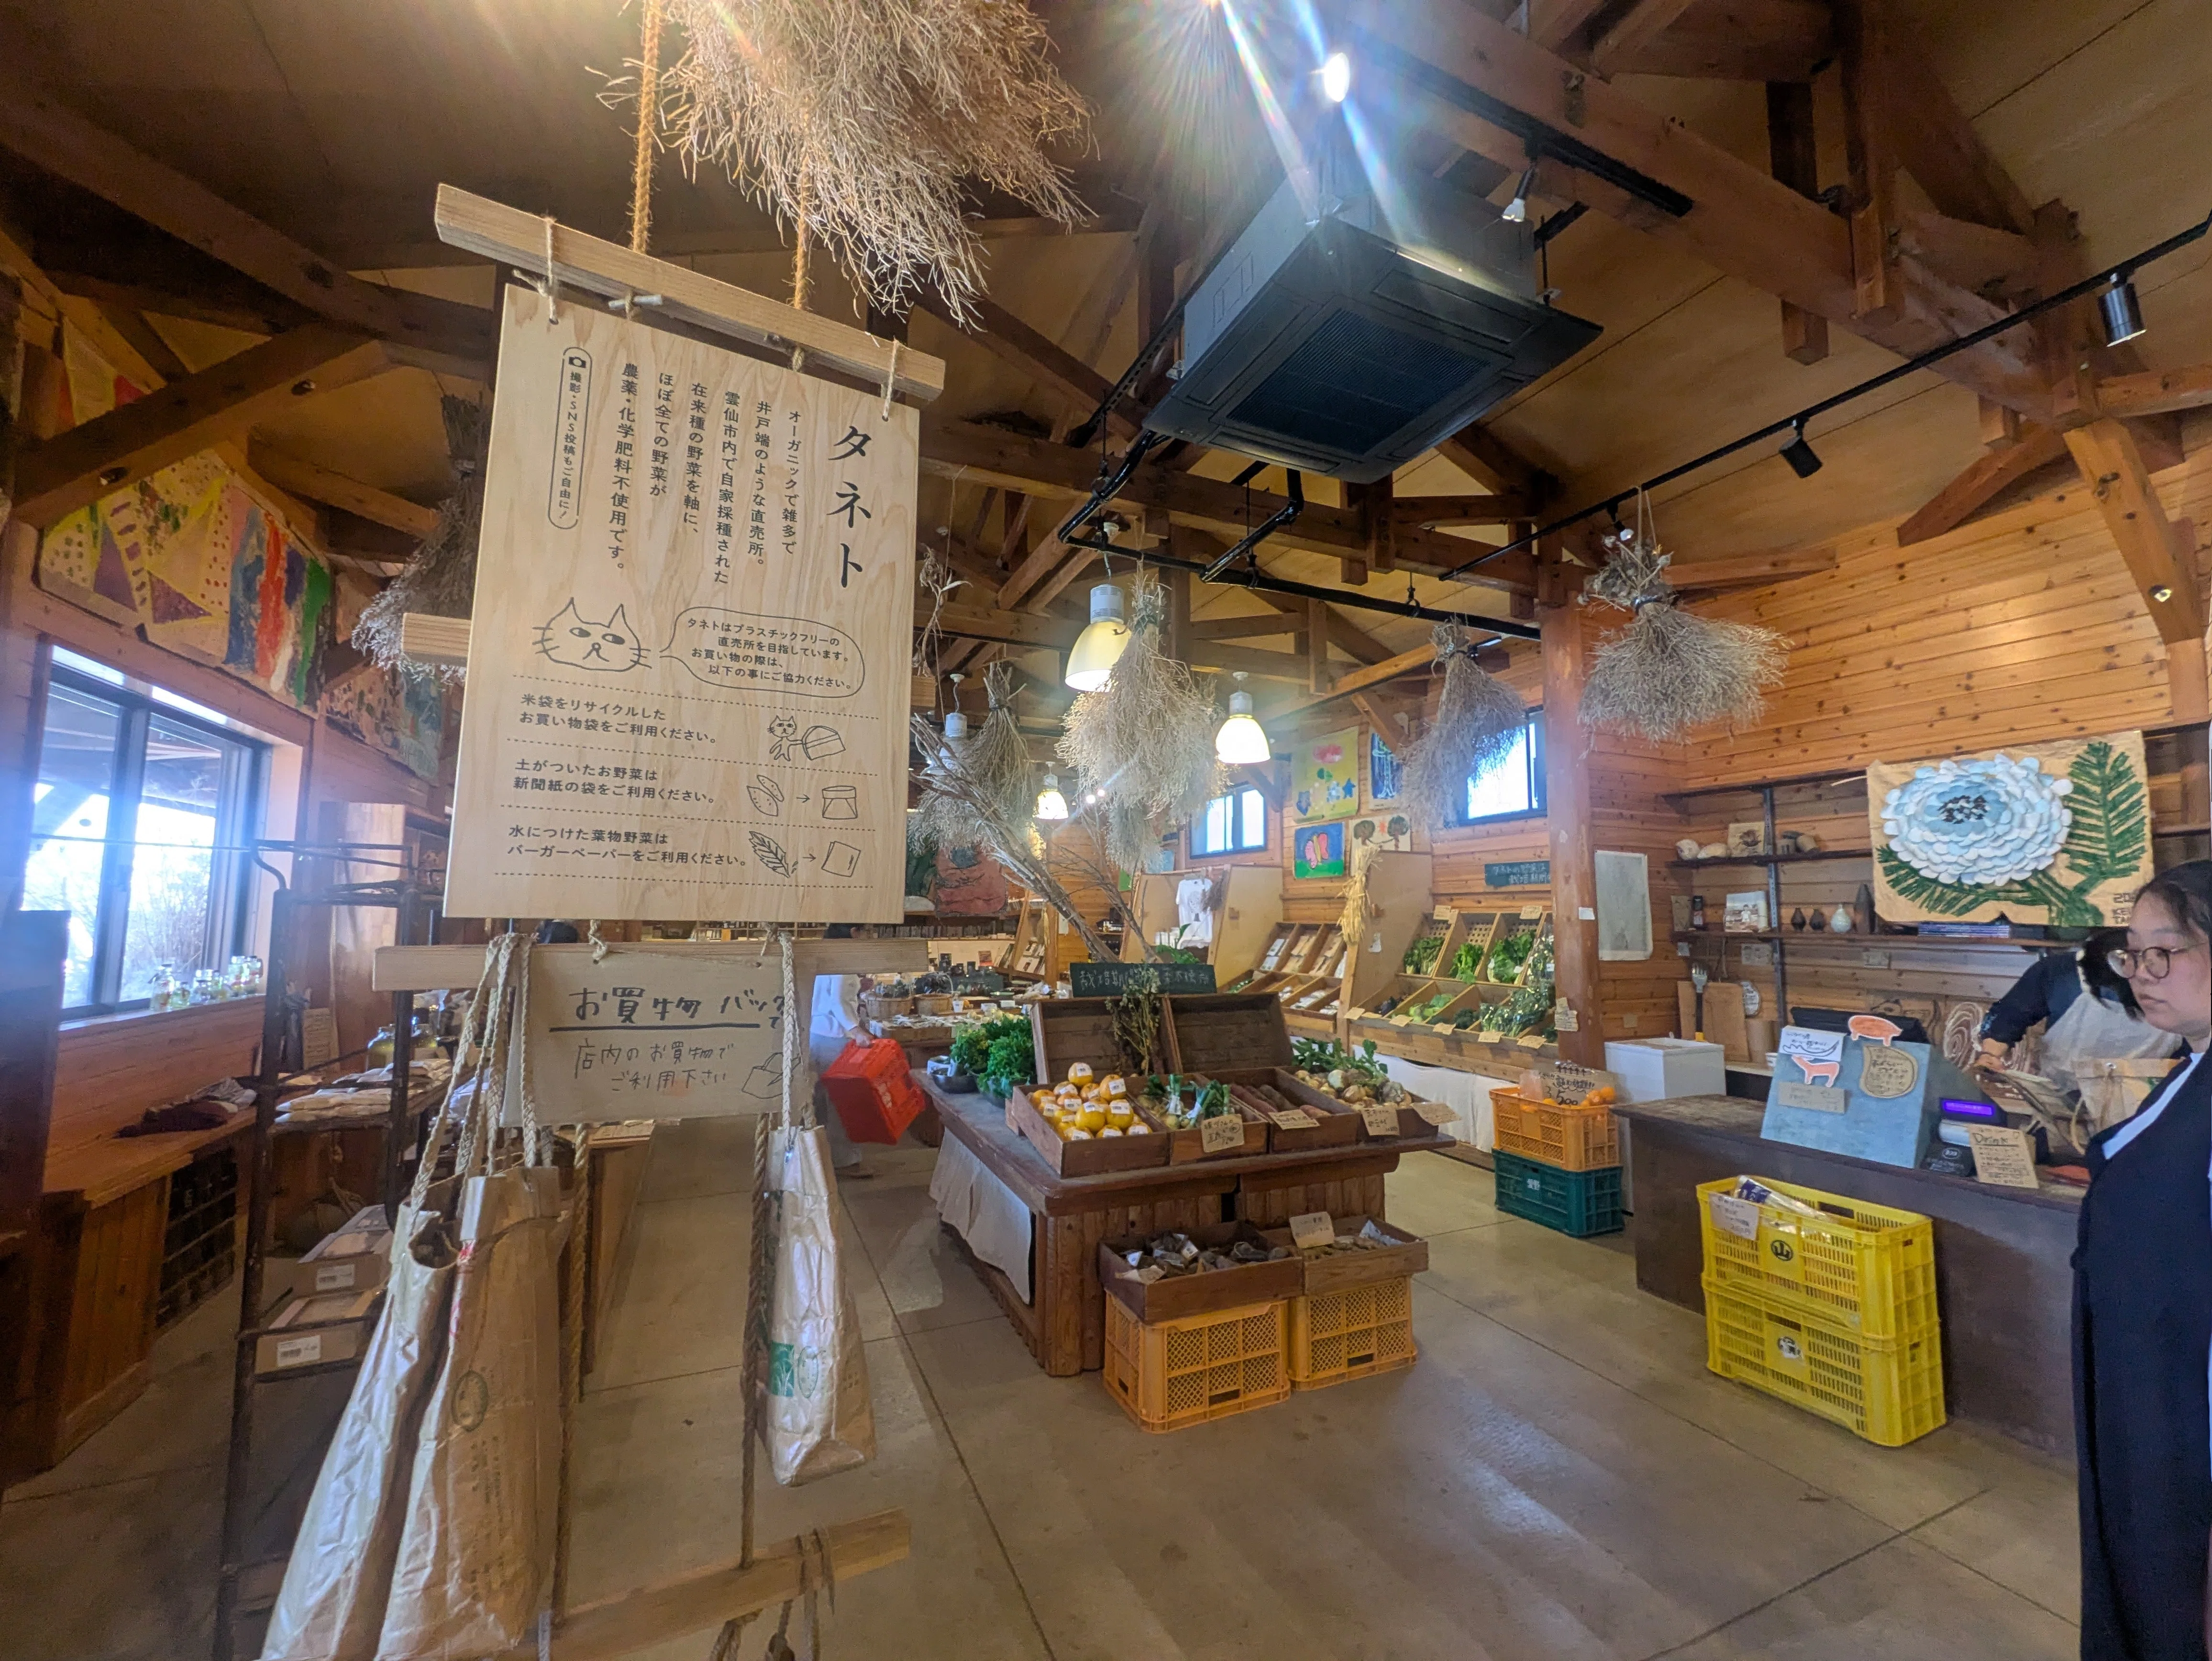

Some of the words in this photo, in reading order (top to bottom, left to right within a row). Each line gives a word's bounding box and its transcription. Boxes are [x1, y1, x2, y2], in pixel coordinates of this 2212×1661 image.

[650, 373, 675, 496] ほぼ全ての野菜が
[608, 363, 638, 568] 農薬・化学肥料不使用です。
[683, 383, 708, 532] 在来種の野菜を軸に、
[715, 391, 740, 584] 雲仙市内で自家採種された
[748, 401, 771, 564] 井戸端のような直売所。
[782, 411, 802, 554] オーガニックで雑多で
[826, 426, 872, 588] タネト
[688, 618, 839, 646] タネトはプラスチックフリーの
[692, 648, 783, 668] お買い物の際は、
[719, 637, 848, 662] 直売所を目指しています。
[708, 664, 851, 689] 以下の事にご協力ください。
[520, 694, 665, 720] 米袋をリサイクルした
[520, 711, 715, 743] お買い物袋をご利用ください。
[515, 759, 657, 780] 土がついたお野菜は
[513, 776, 713, 803] 新聞紙の袋をご利用ください。
[509, 825, 668, 844] 水につけた葉物野菜は
[508, 845, 745, 865] バーガーペーパーをご利用ください。
[612, 1069, 726, 1091] ご利用下さい
